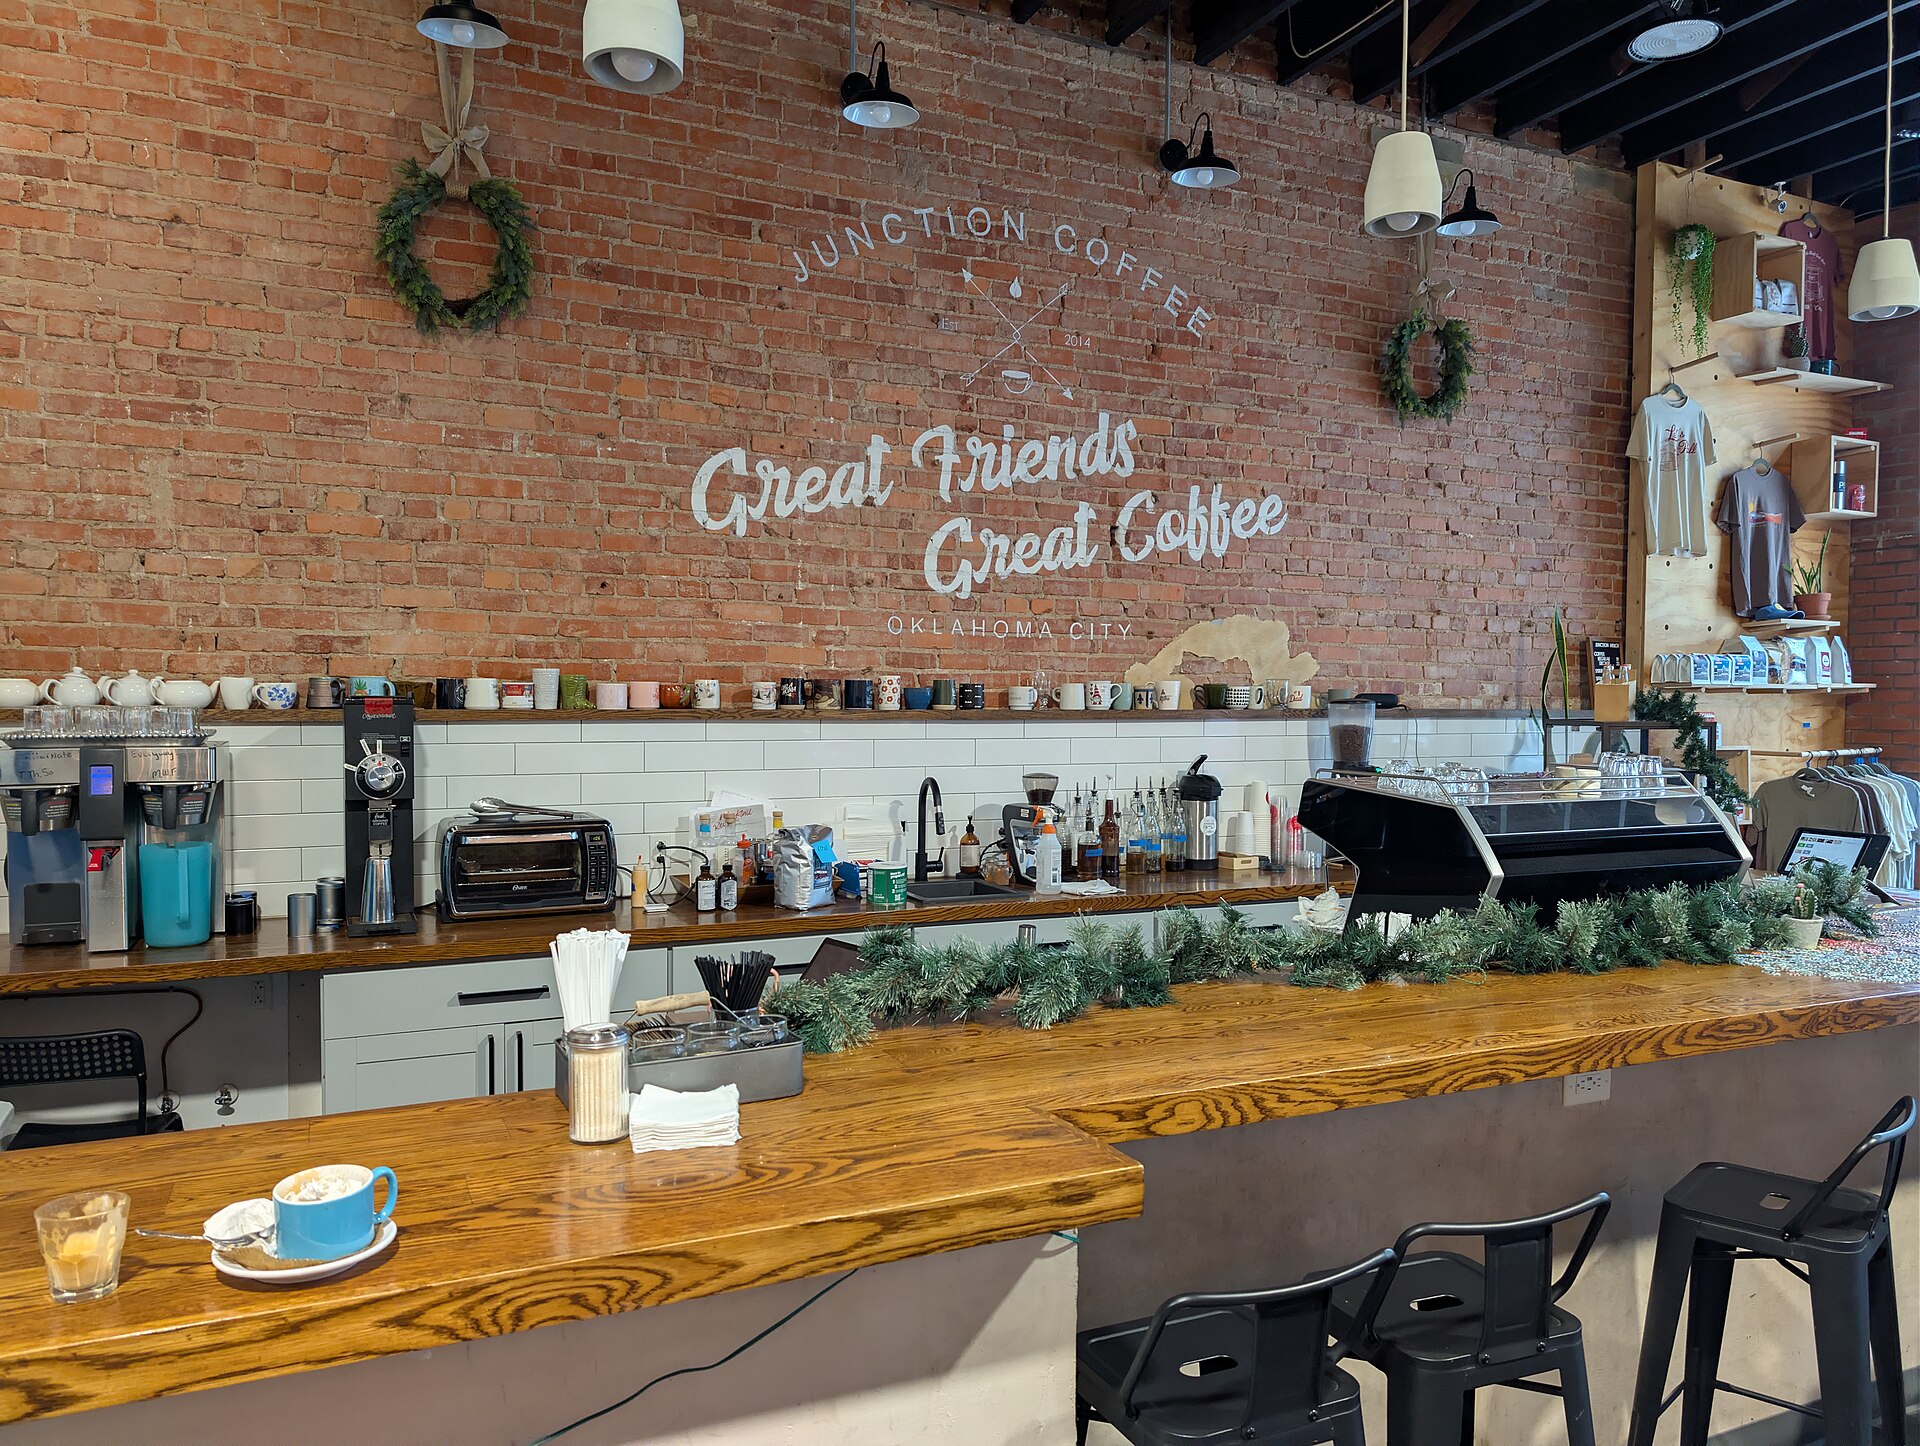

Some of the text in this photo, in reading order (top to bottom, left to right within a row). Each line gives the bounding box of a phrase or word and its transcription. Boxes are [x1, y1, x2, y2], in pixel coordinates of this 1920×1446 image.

[793, 206, 1213, 339] JUNCTION COFFEE
[1064, 334, 1091, 349] 2014
[691, 411, 1138, 537] Great Friends
[923, 483, 1289, 599] Great Coffee
[887, 615, 1133, 641] OKLAHOMA CITY
